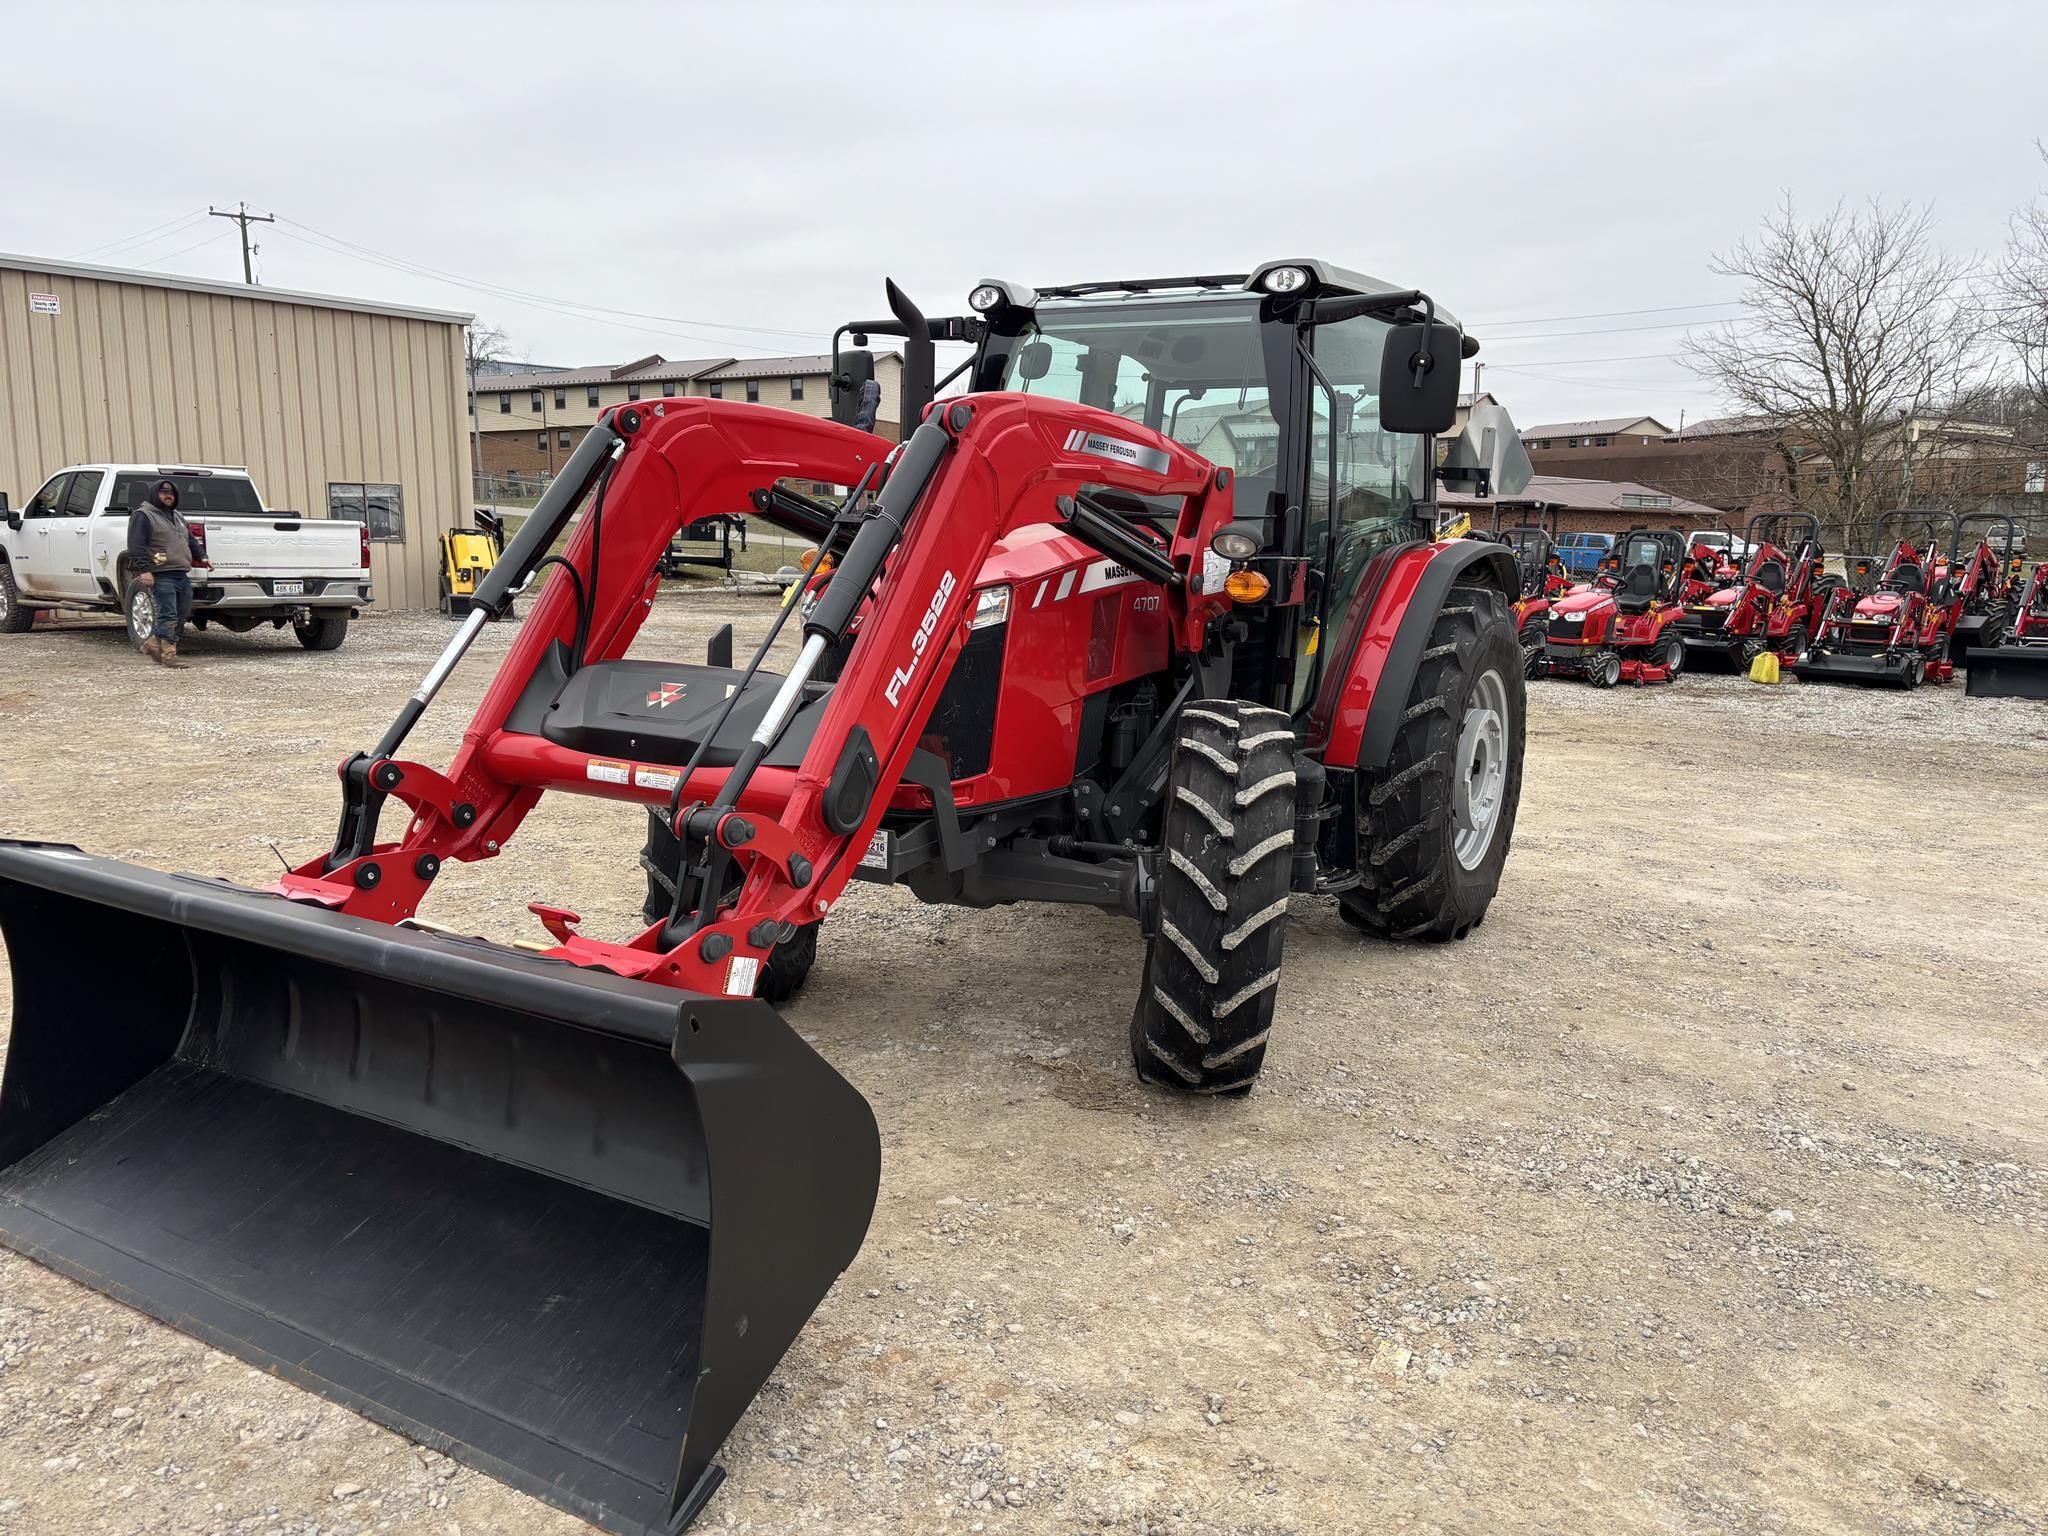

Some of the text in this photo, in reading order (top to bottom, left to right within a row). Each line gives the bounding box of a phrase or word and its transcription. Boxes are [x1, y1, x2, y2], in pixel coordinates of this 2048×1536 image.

[1087, 439, 1137, 459] MASSEY FERGUSON
[1133, 596, 1160, 612] 4707
[884, 569, 957, 709] FL.3522
